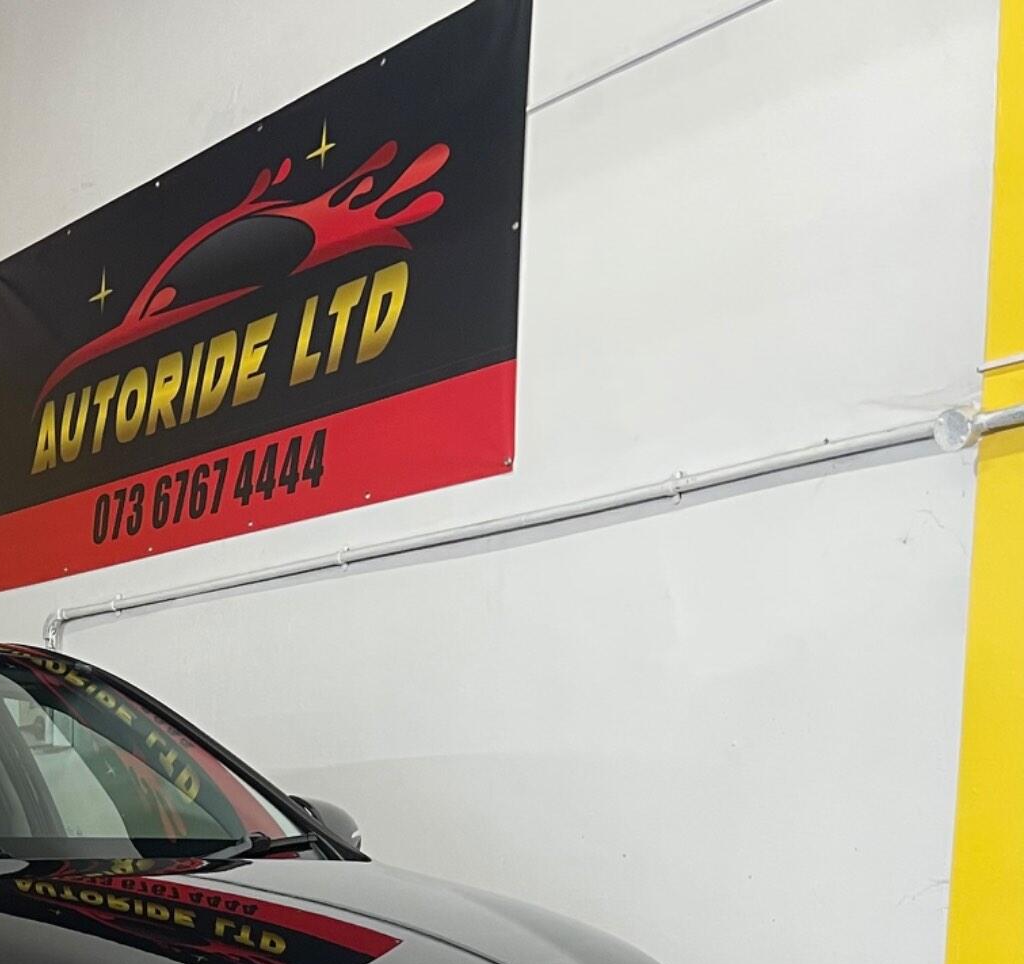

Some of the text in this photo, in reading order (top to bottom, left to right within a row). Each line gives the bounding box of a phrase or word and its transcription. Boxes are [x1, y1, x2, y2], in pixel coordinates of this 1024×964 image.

[30, 261, 409, 475] AUTORIDE LTD
[91, 428, 328, 544] 073 6767 4444
